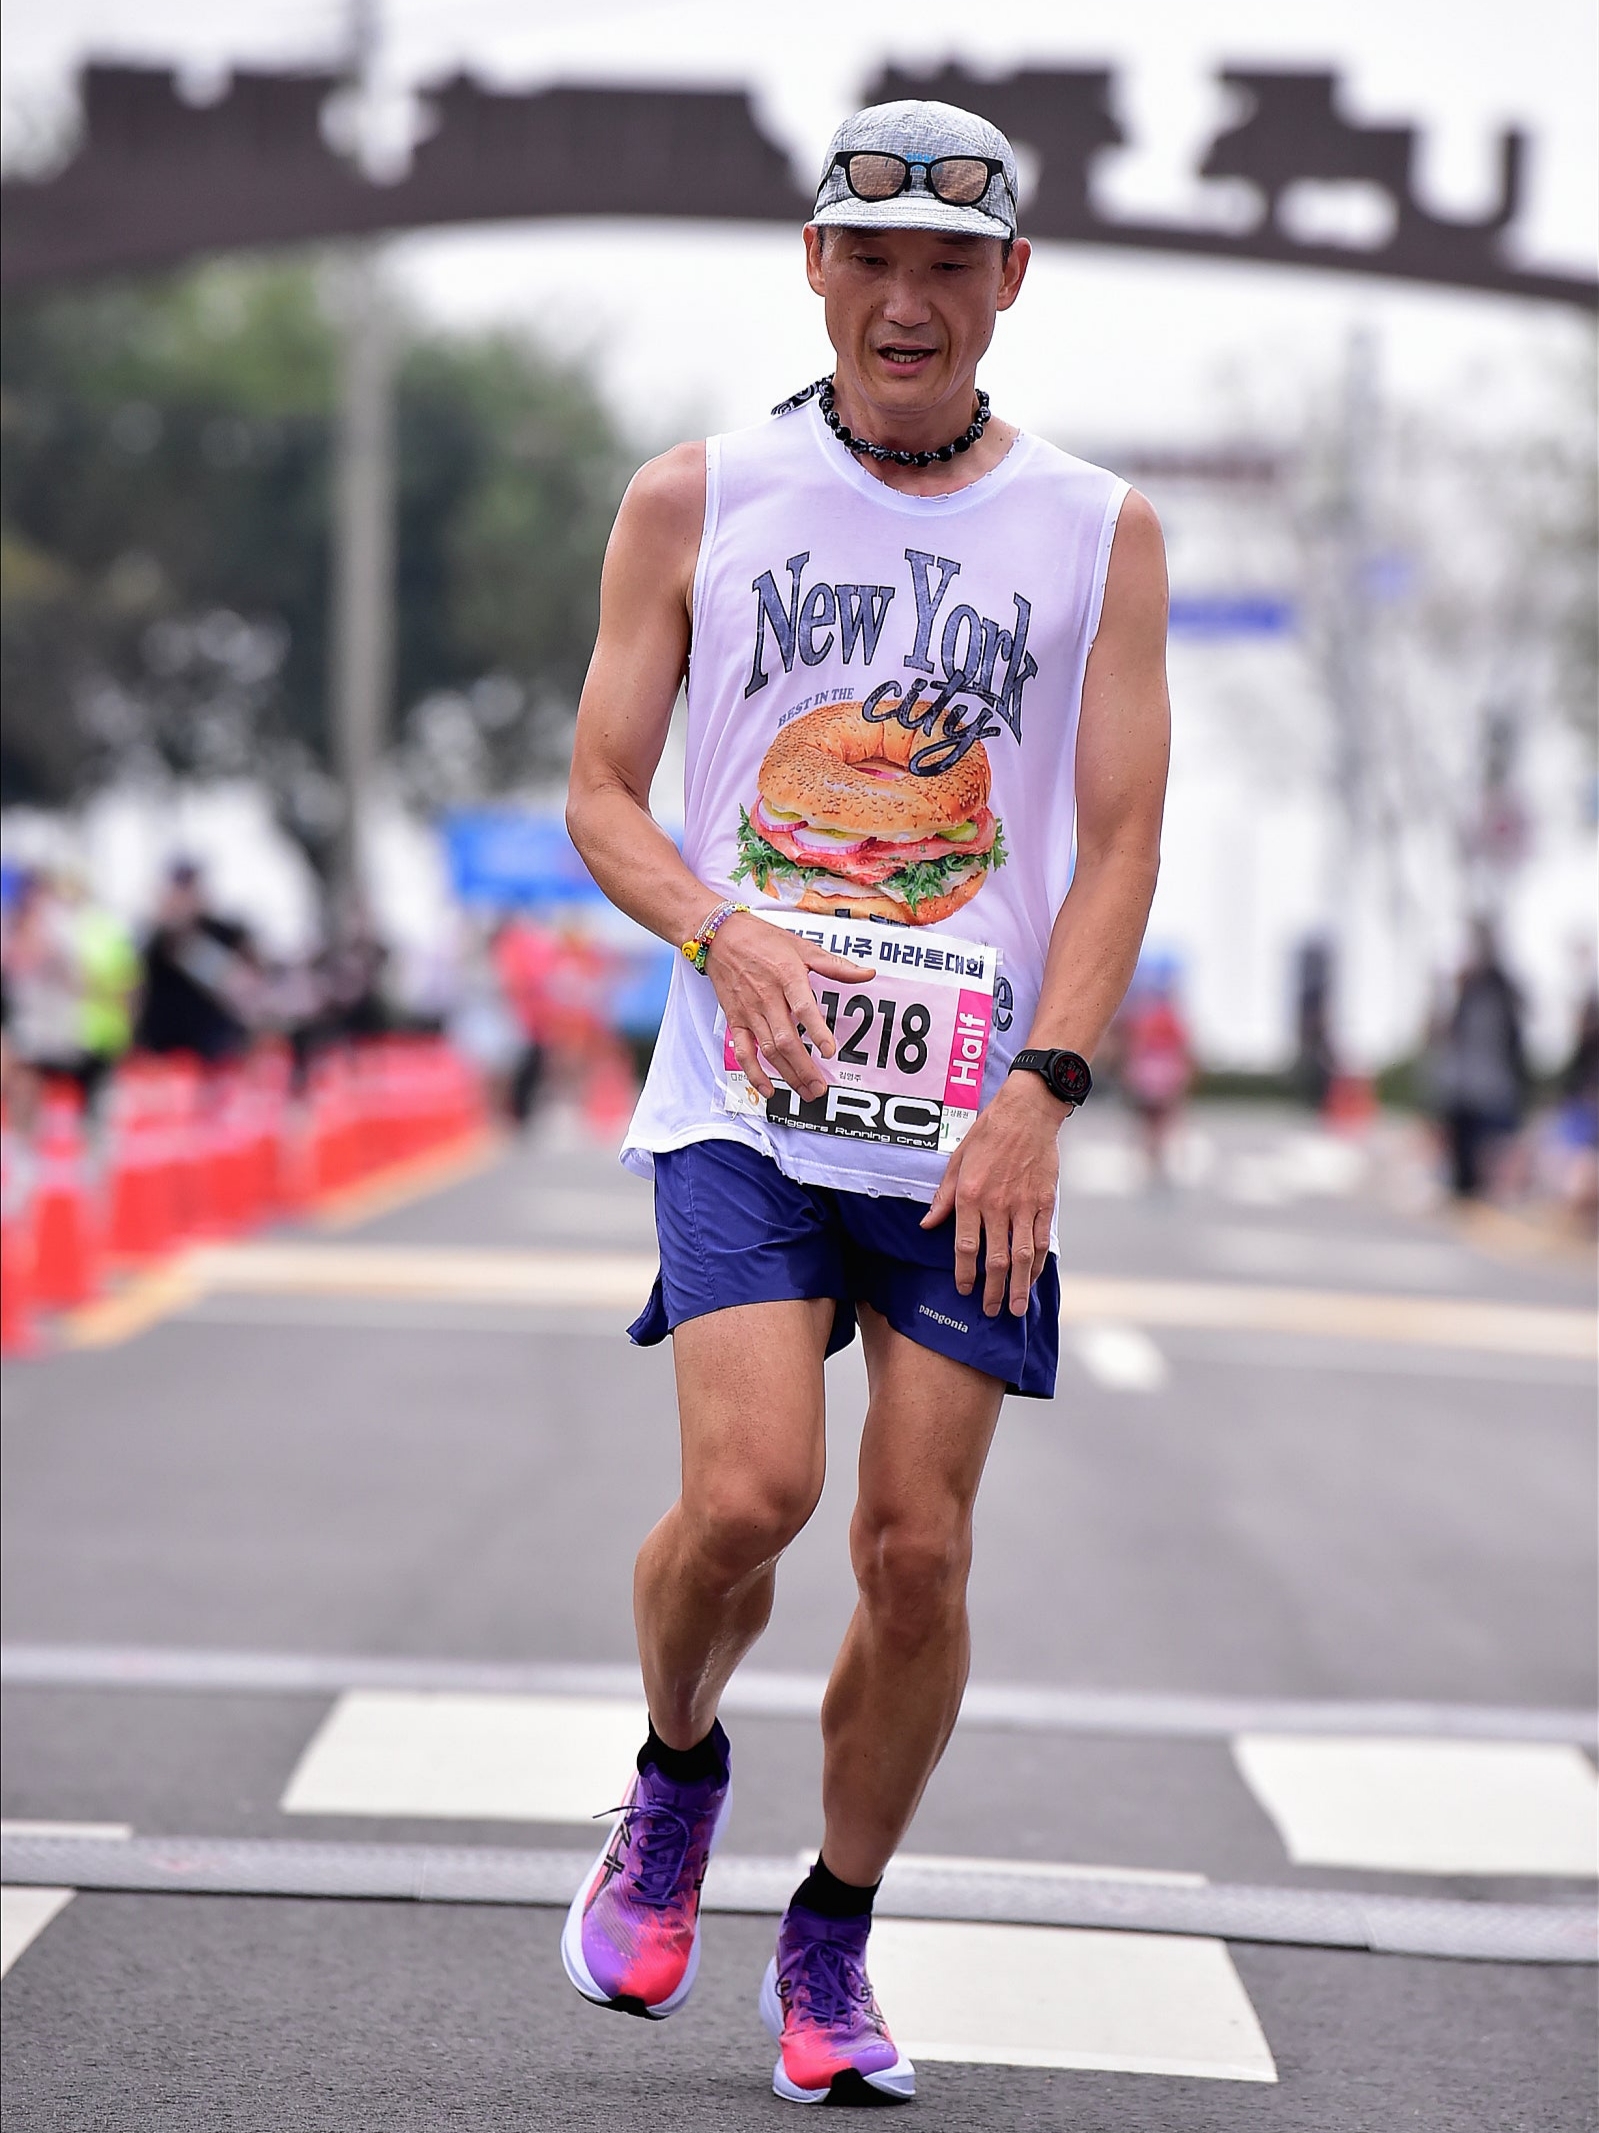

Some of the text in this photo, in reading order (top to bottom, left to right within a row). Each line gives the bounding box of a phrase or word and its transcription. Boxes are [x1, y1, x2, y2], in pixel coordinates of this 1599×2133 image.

[745, 548, 1038, 745] New York
[777, 687, 854, 729] BEST IN THE
[862, 669, 1001, 777] city
[830, 934, 873, 959] 나주
[879, 941, 984, 979] 마라톤대회
[950, 1012, 986, 1087] Half
[769, 1115, 829, 1133] Triggers
[835, 1126, 891, 1143] Running
[896, 1136, 937, 1148] Crew
[773, 1079, 940, 1136] TRC
[919, 1304, 969, 1333] patagonia
